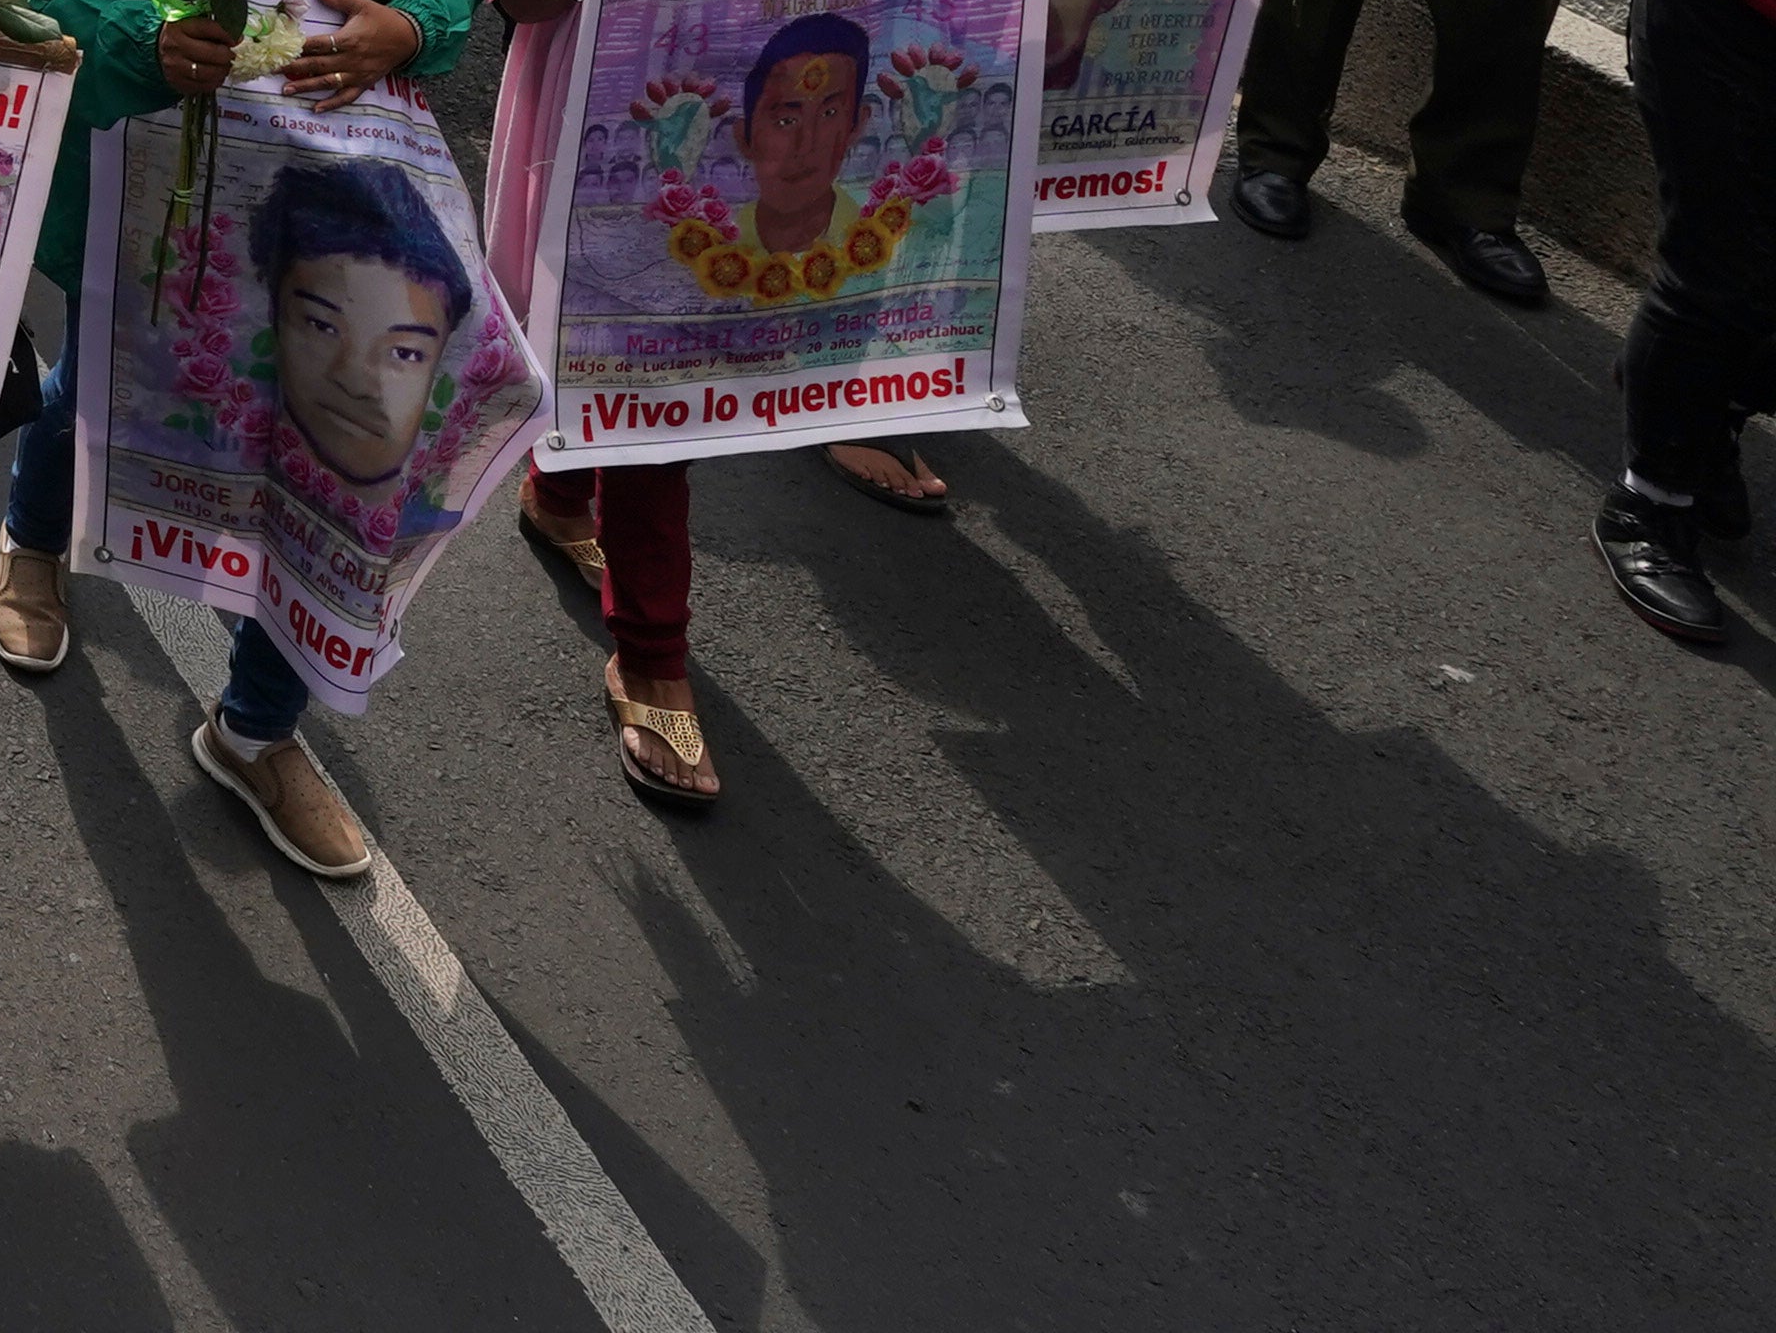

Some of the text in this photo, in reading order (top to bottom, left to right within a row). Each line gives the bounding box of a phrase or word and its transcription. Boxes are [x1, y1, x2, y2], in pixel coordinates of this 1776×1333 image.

[1050, 104, 1158, 138] GARCÍA
[568, 324, 985, 376] Hijo de Luciano y Eudocia 20 años Xalpatlahuac
[626, 301, 934, 357] Marcial Pablo Baranda
[580, 358, 966, 443] ¡Vivo lo queremos!
